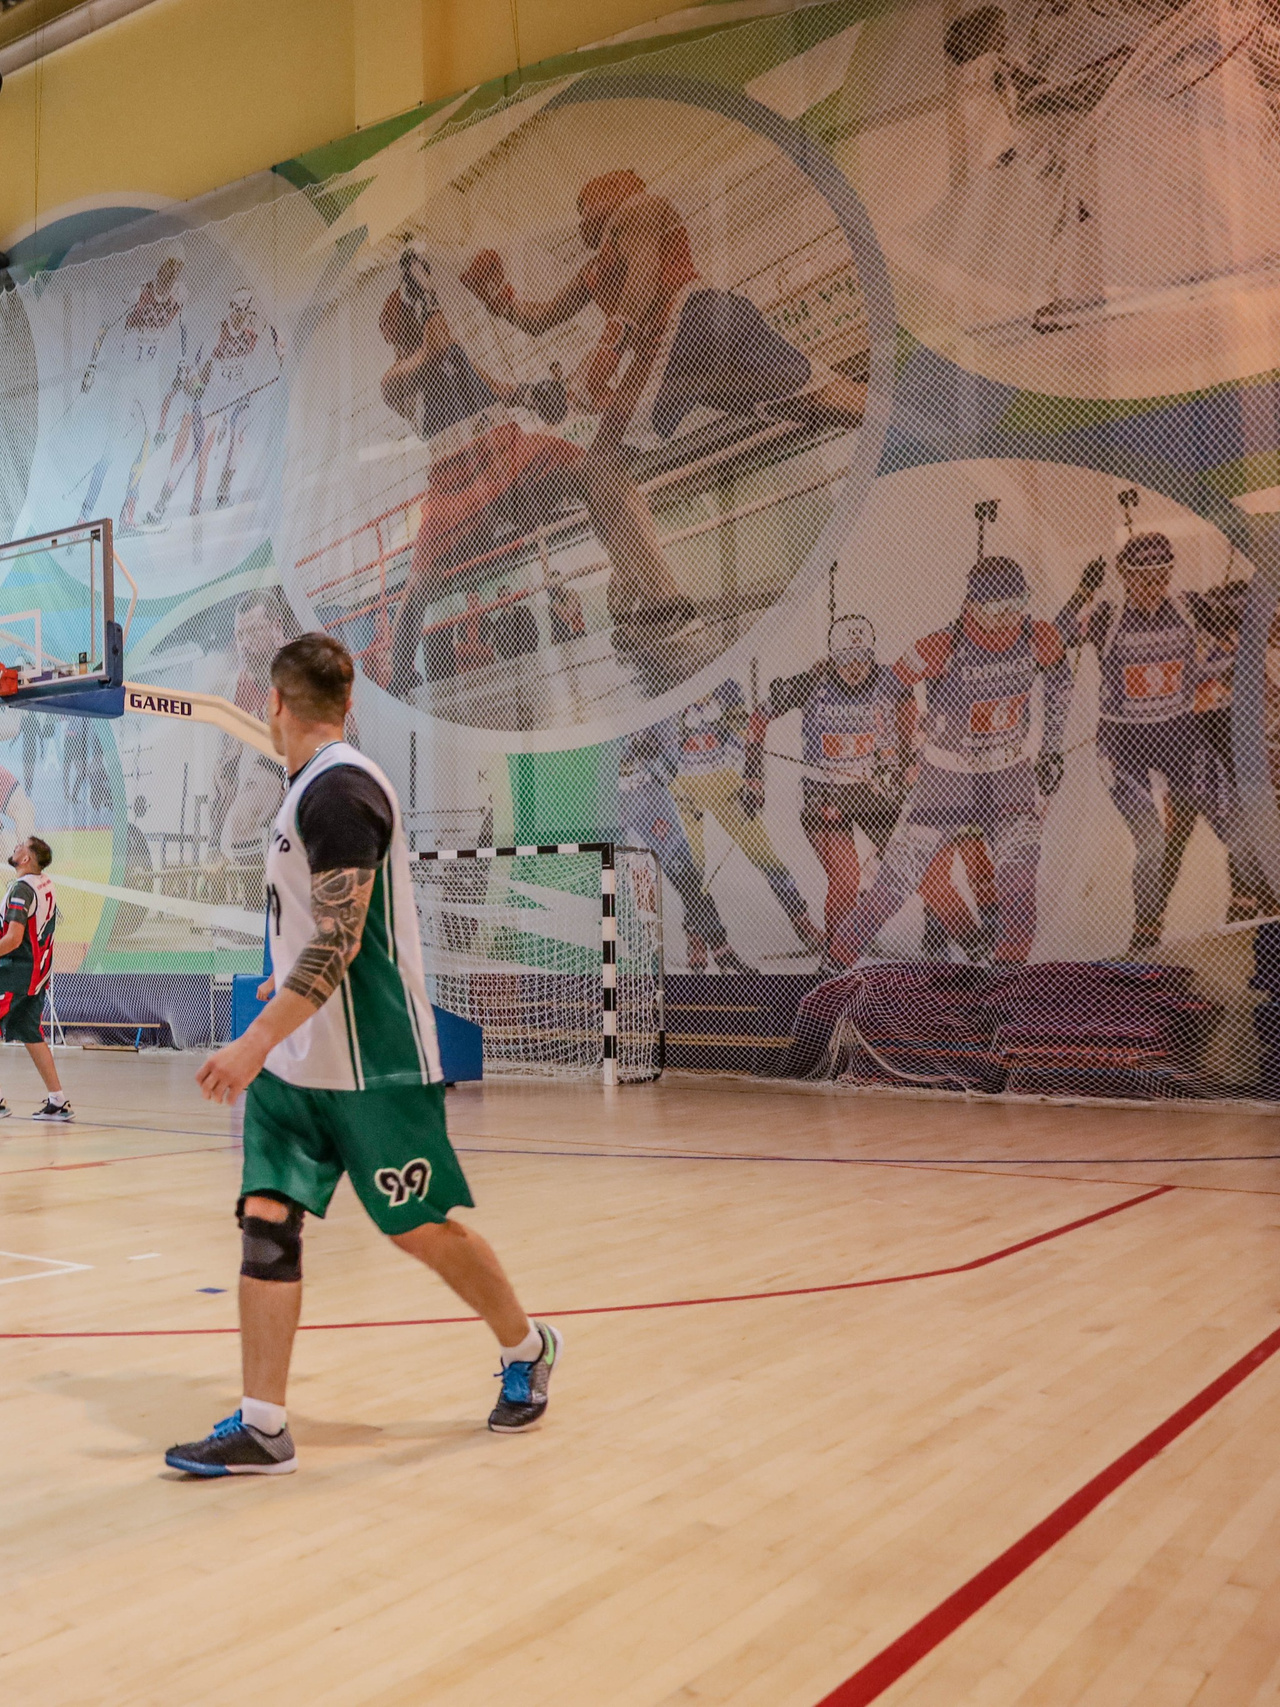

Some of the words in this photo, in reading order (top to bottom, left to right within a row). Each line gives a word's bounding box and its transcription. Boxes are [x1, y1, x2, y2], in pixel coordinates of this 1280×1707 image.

[130, 693, 192, 716] GARED
[45, 891, 53, 920] 7
[374, 1157, 432, 1207] 99
